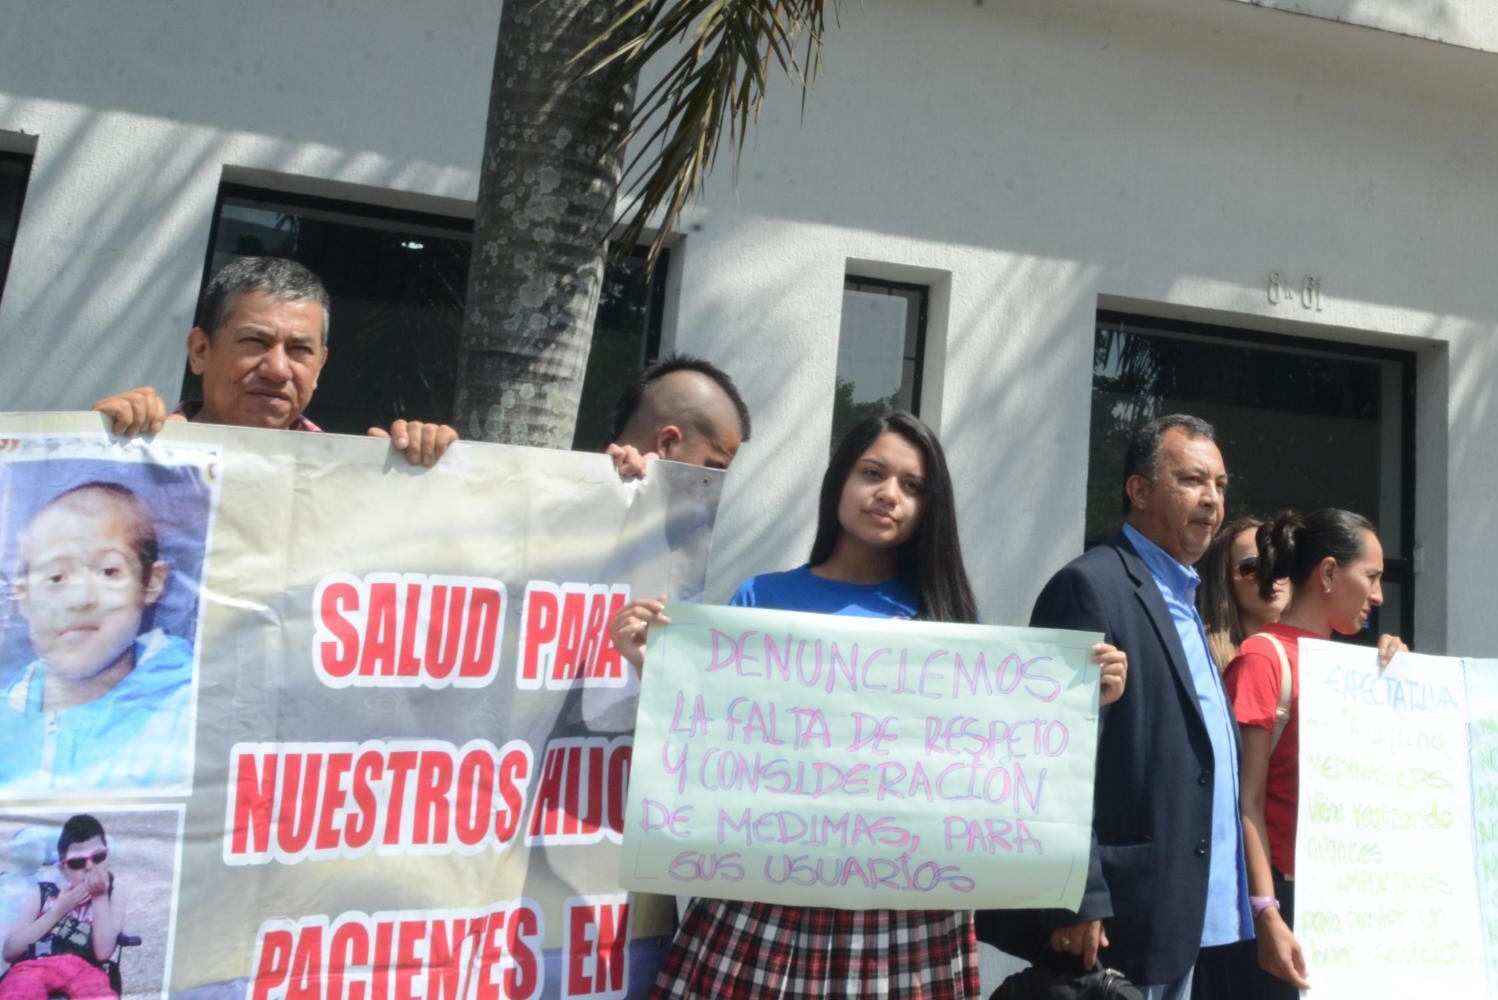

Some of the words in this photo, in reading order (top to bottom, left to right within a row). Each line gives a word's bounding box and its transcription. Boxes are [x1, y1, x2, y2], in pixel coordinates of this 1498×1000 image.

[319, 583, 501, 679] SALUD
[523, 586, 627, 680] PARA
[704, 628, 1063, 702] DENUNCIEMOS
[1326, 665, 1460, 713] EXPECTATIVA
[669, 690, 715, 738] LA
[726, 697, 831, 750] FALTA
[848, 711, 899, 756] DE
[925, 715, 1070, 760] RESPETO
[231, 749, 528, 855] NUESTROS
[529, 746, 632, 837] HIJO
[662, 741, 689, 794] Y
[641, 798, 694, 838] DE
[943, 815, 1043, 854] PARA
[668, 850, 745, 883] SUS
[252, 905, 538, 1000] PACIENTES
[567, 903, 629, 997] EN
